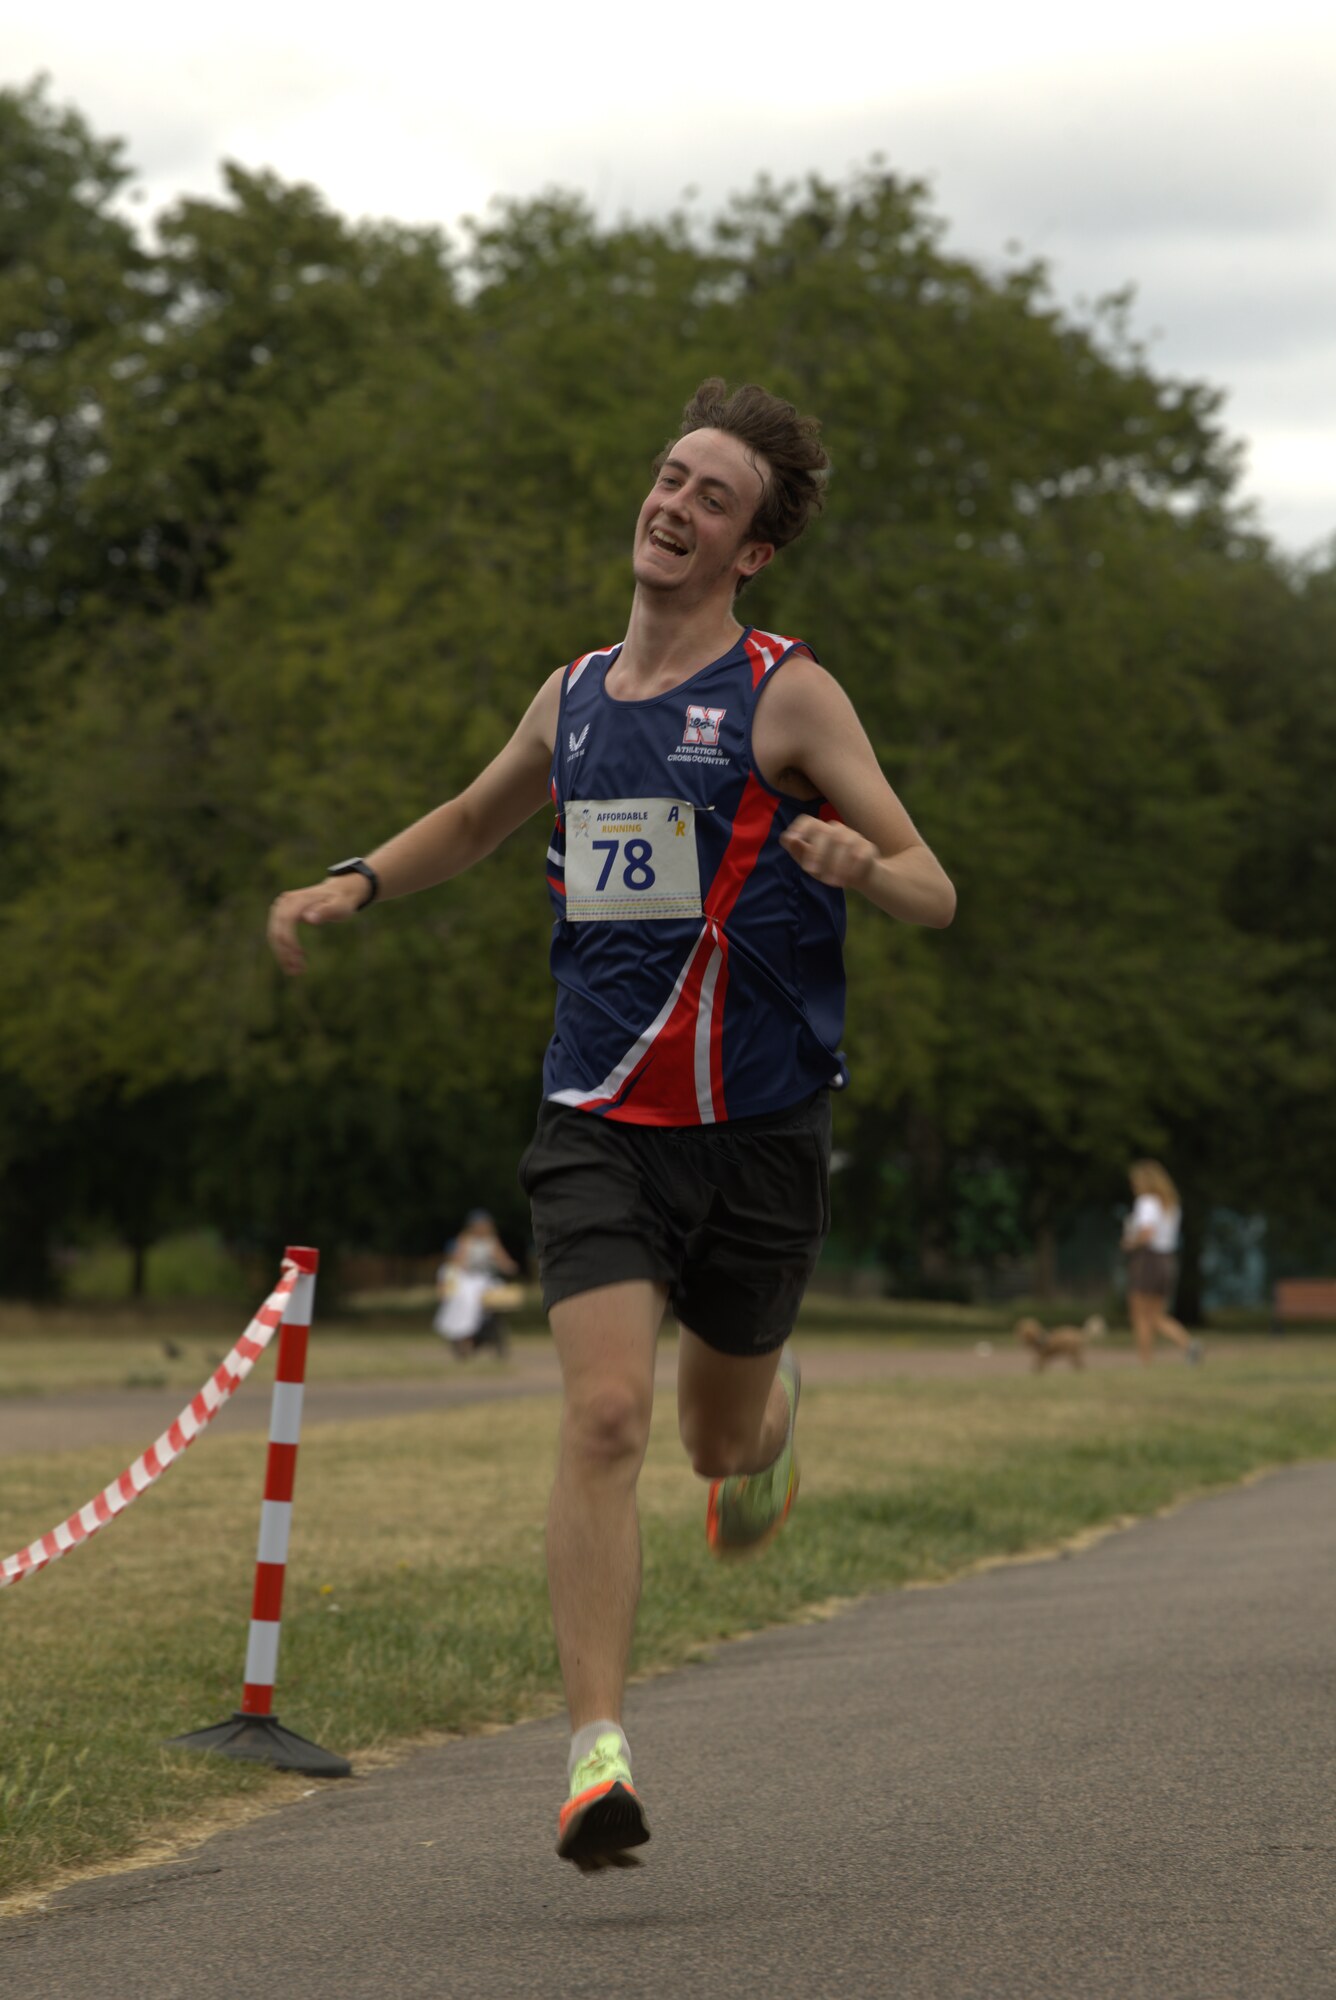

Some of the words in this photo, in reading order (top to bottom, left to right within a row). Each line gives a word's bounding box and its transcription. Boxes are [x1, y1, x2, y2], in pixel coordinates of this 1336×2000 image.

[683, 705, 727, 746] N
[675, 745, 717, 756] ATHLETICS
[596, 811, 648, 822] AFFORDABLE
[602, 824, 642, 833] RUNNING
[592, 838, 656, 892] 78
